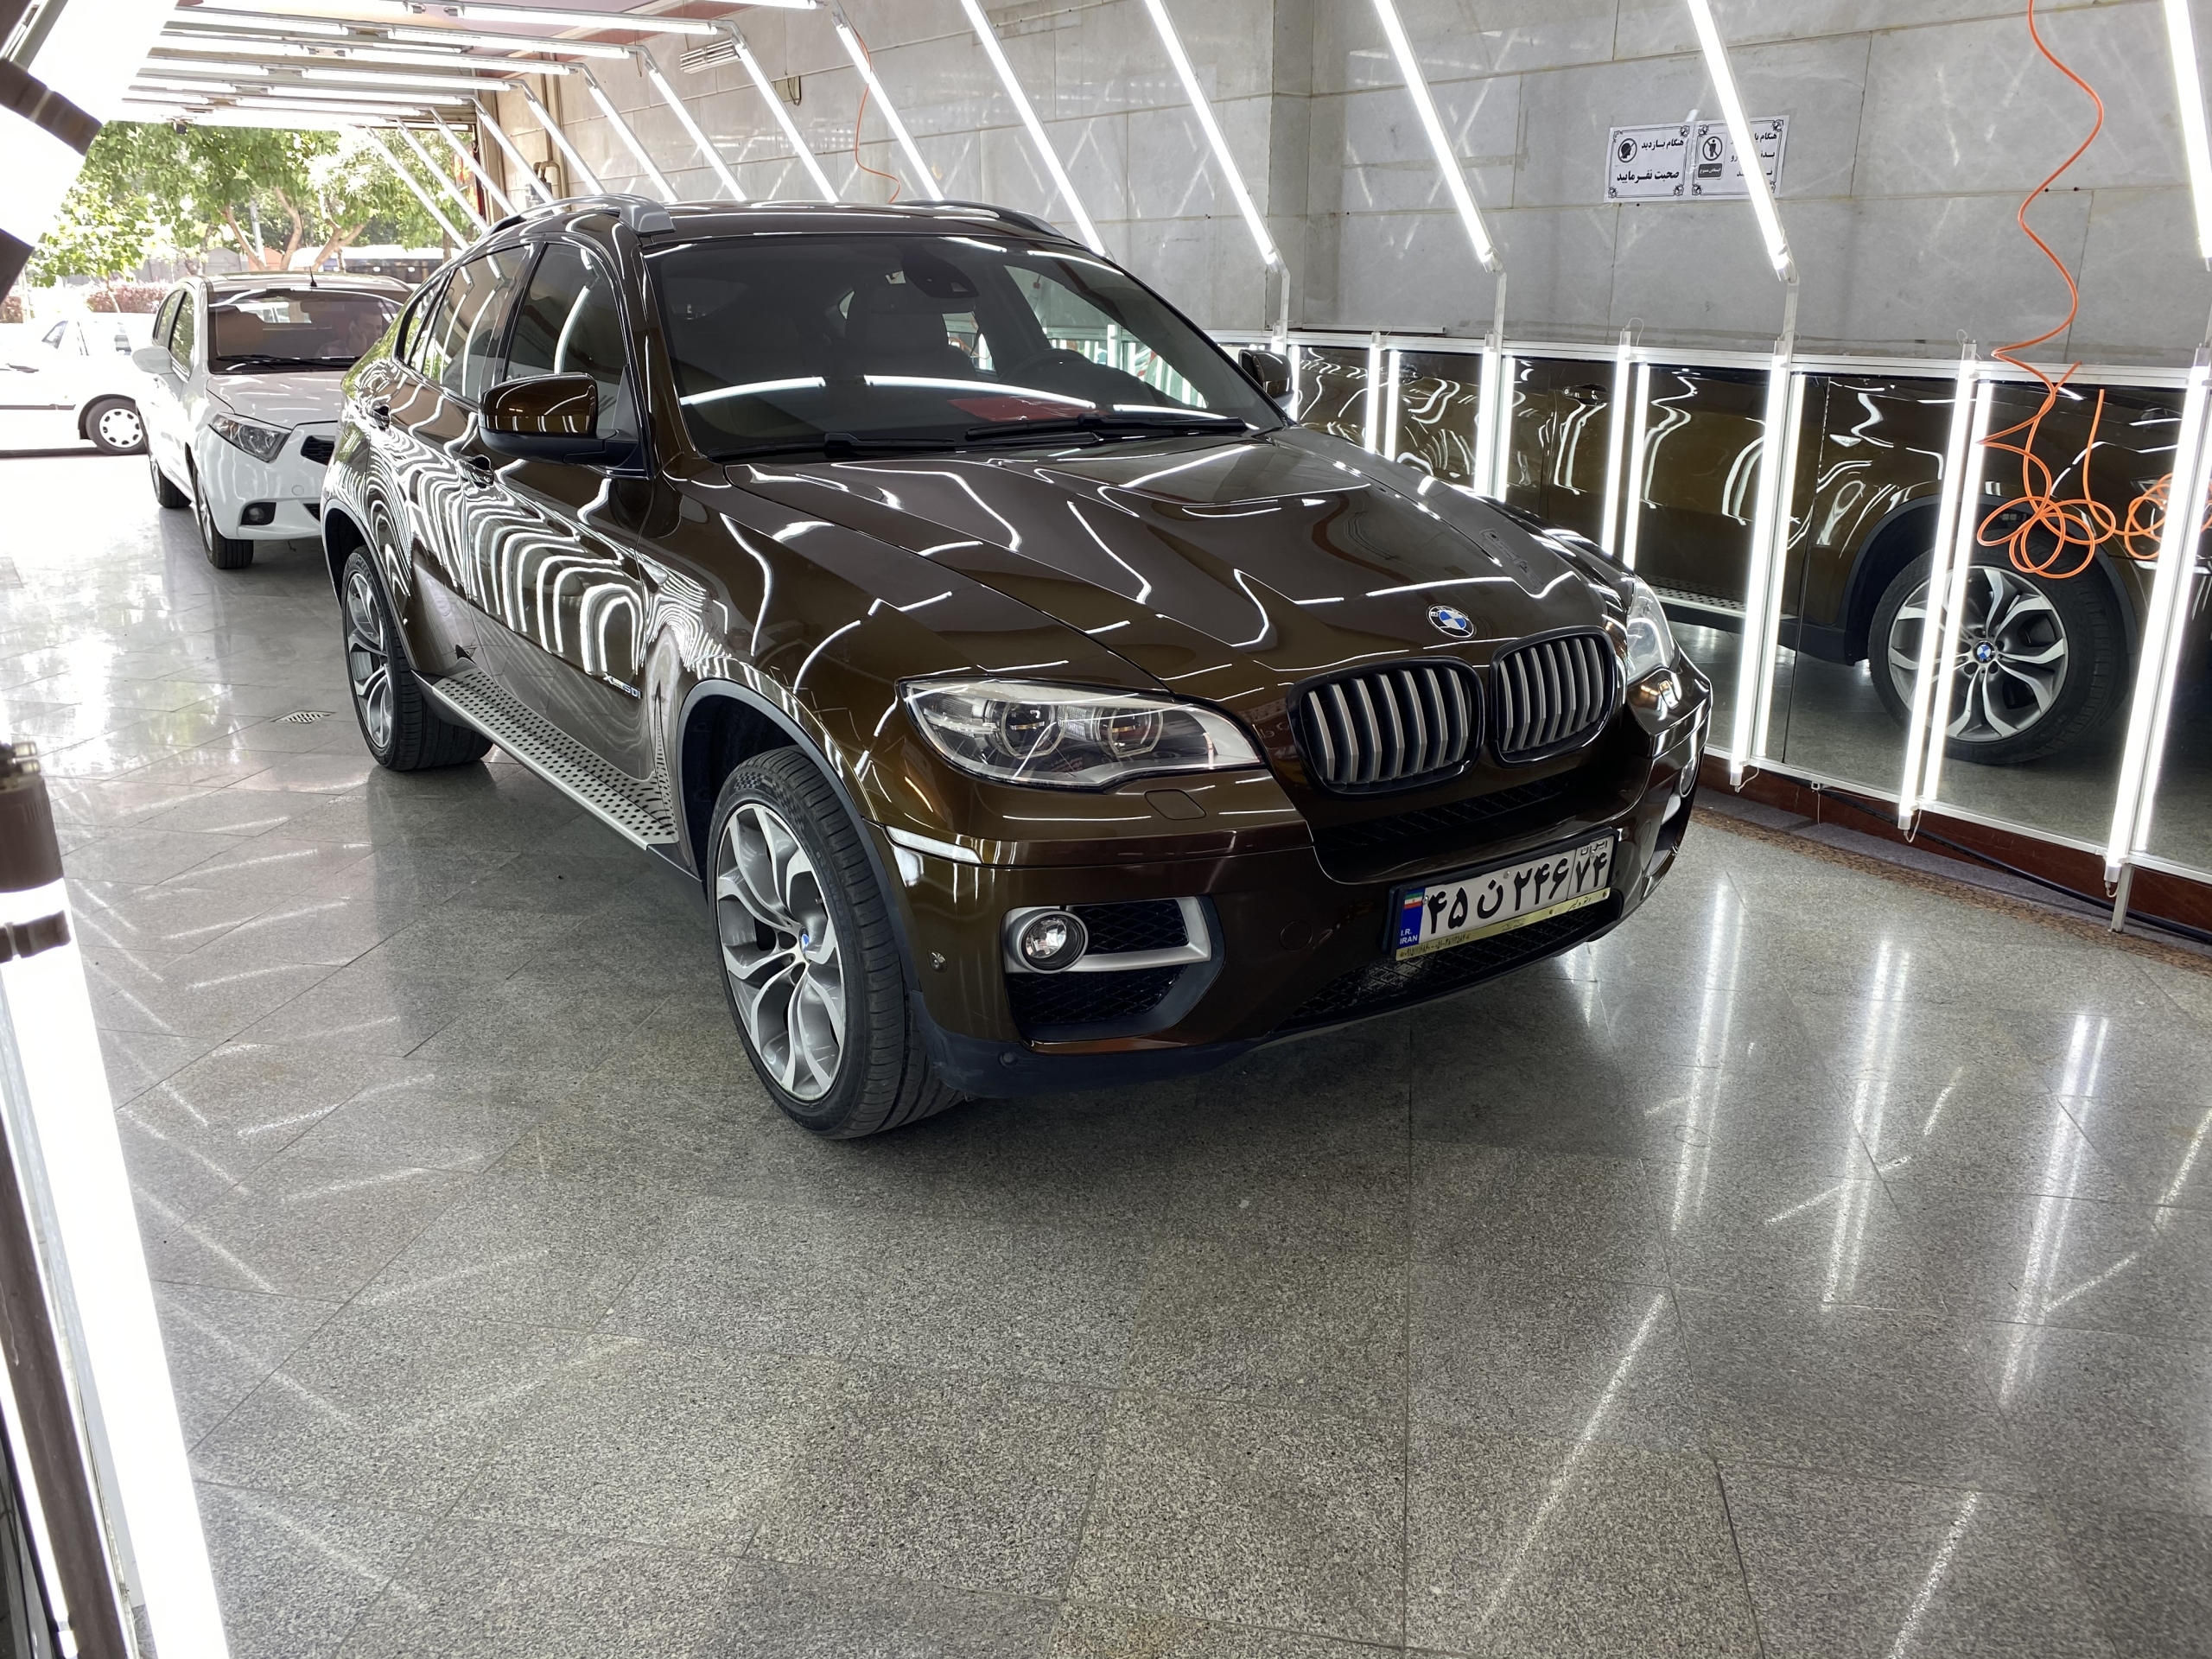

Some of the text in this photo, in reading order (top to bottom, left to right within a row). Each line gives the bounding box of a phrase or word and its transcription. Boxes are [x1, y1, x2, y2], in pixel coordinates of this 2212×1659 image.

[1641, 138, 1684, 150] هنگام بازدید
[1617, 168, 1680, 184] صحبت نفرمایید
[1580, 840, 1608, 856] ایران
[1575, 852, 1608, 893] ۷۴
[1399, 934, 1418, 945] IRAN
[1400, 928, 1412, 937] I.R.
